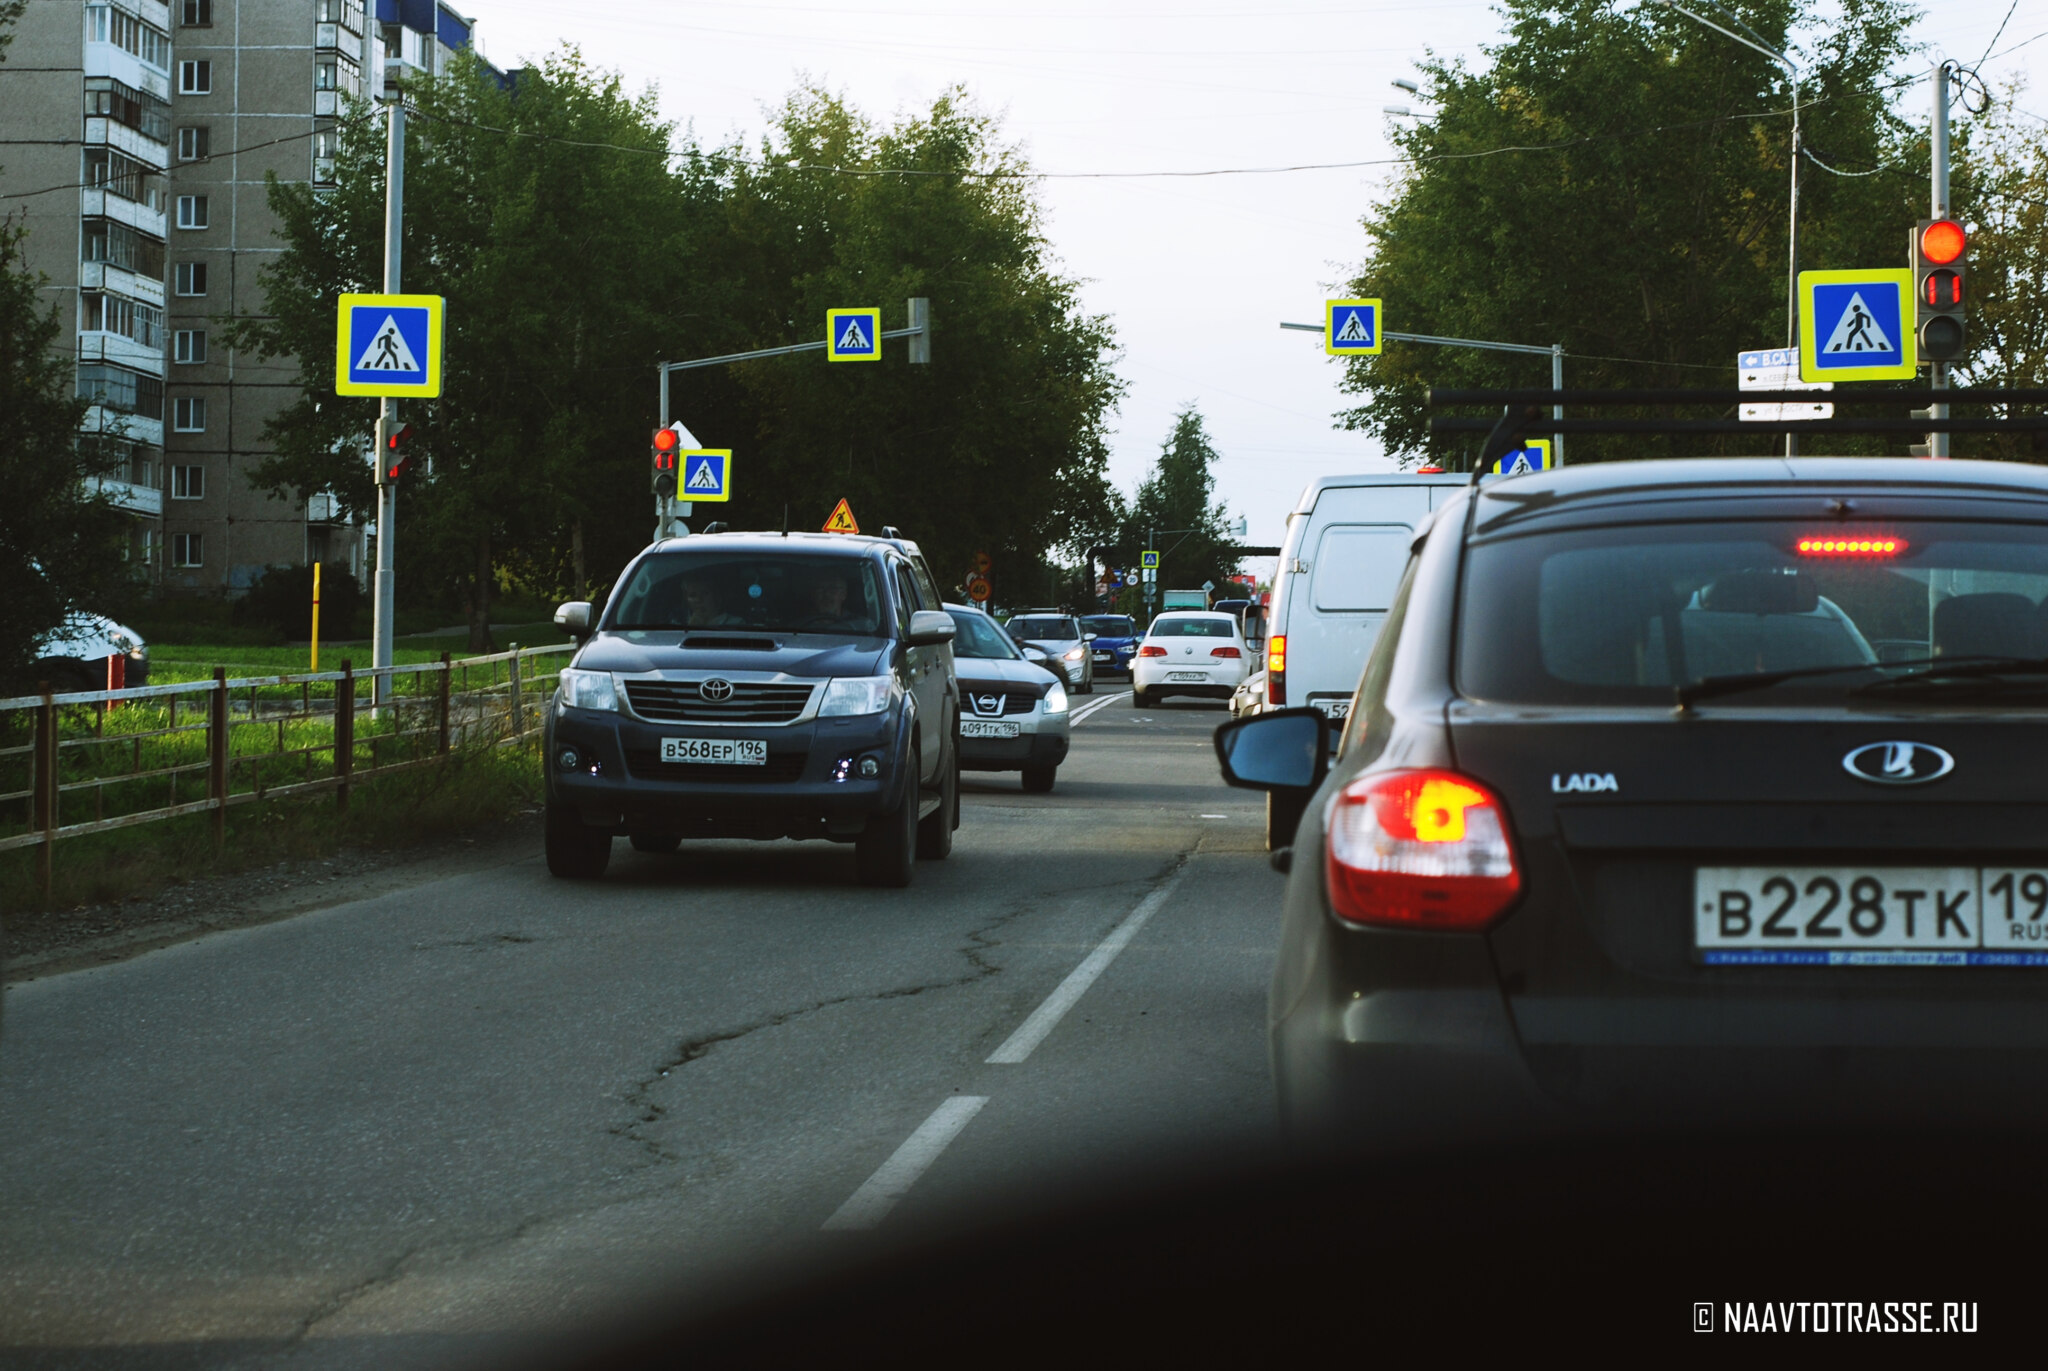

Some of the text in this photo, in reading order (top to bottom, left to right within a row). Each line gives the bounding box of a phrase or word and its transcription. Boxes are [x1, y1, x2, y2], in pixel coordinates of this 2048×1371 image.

[973, 585, 986, 594] 40
[666, 741, 763, 759] В568ЕР 196
[1551, 773, 1618, 792] LADA
[1718, 876, 1971, 938] В228ТК
